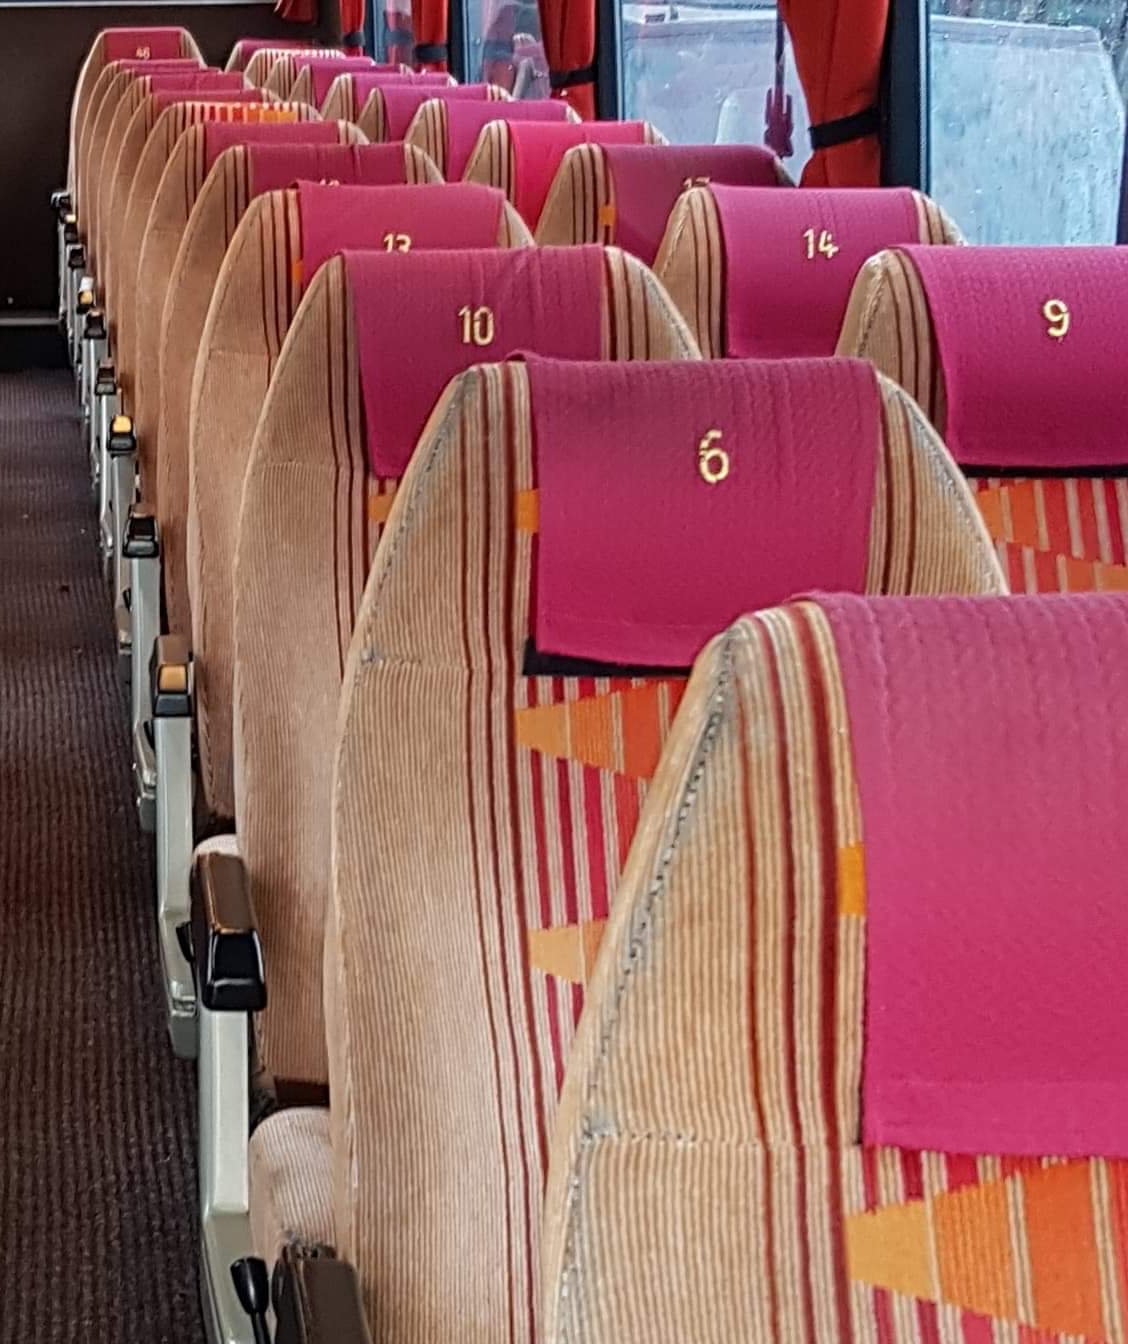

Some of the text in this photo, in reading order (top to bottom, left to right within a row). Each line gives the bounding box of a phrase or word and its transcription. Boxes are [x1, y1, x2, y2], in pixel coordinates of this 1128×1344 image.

[803, 228, 839, 259] 14
[458, 305, 494, 346] 10
[1043, 299, 1070, 338] 9
[698, 429, 729, 484] 6
